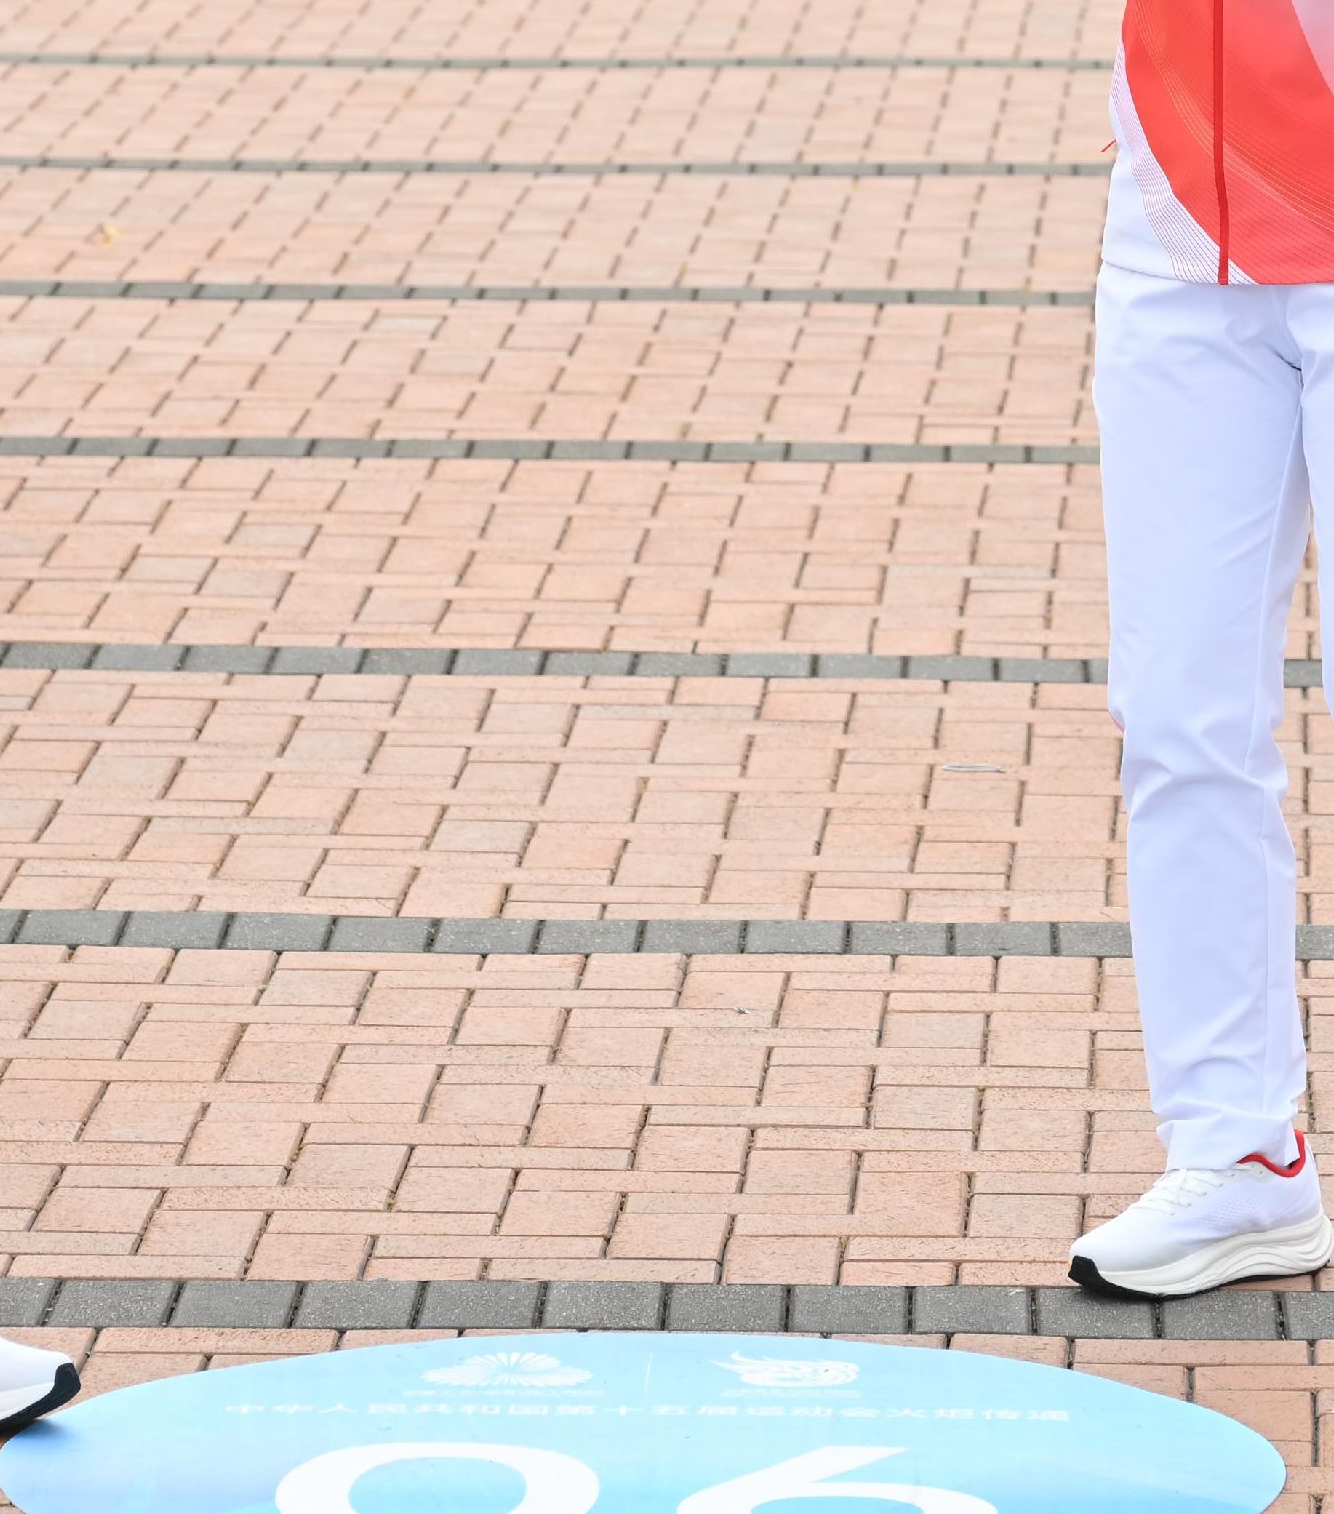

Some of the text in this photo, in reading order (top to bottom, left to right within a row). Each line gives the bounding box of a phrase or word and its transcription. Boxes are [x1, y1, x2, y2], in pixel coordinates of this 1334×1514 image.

[225, 1402, 1074, 1422] 中华人民共和国第十五届运动会火炬传递
